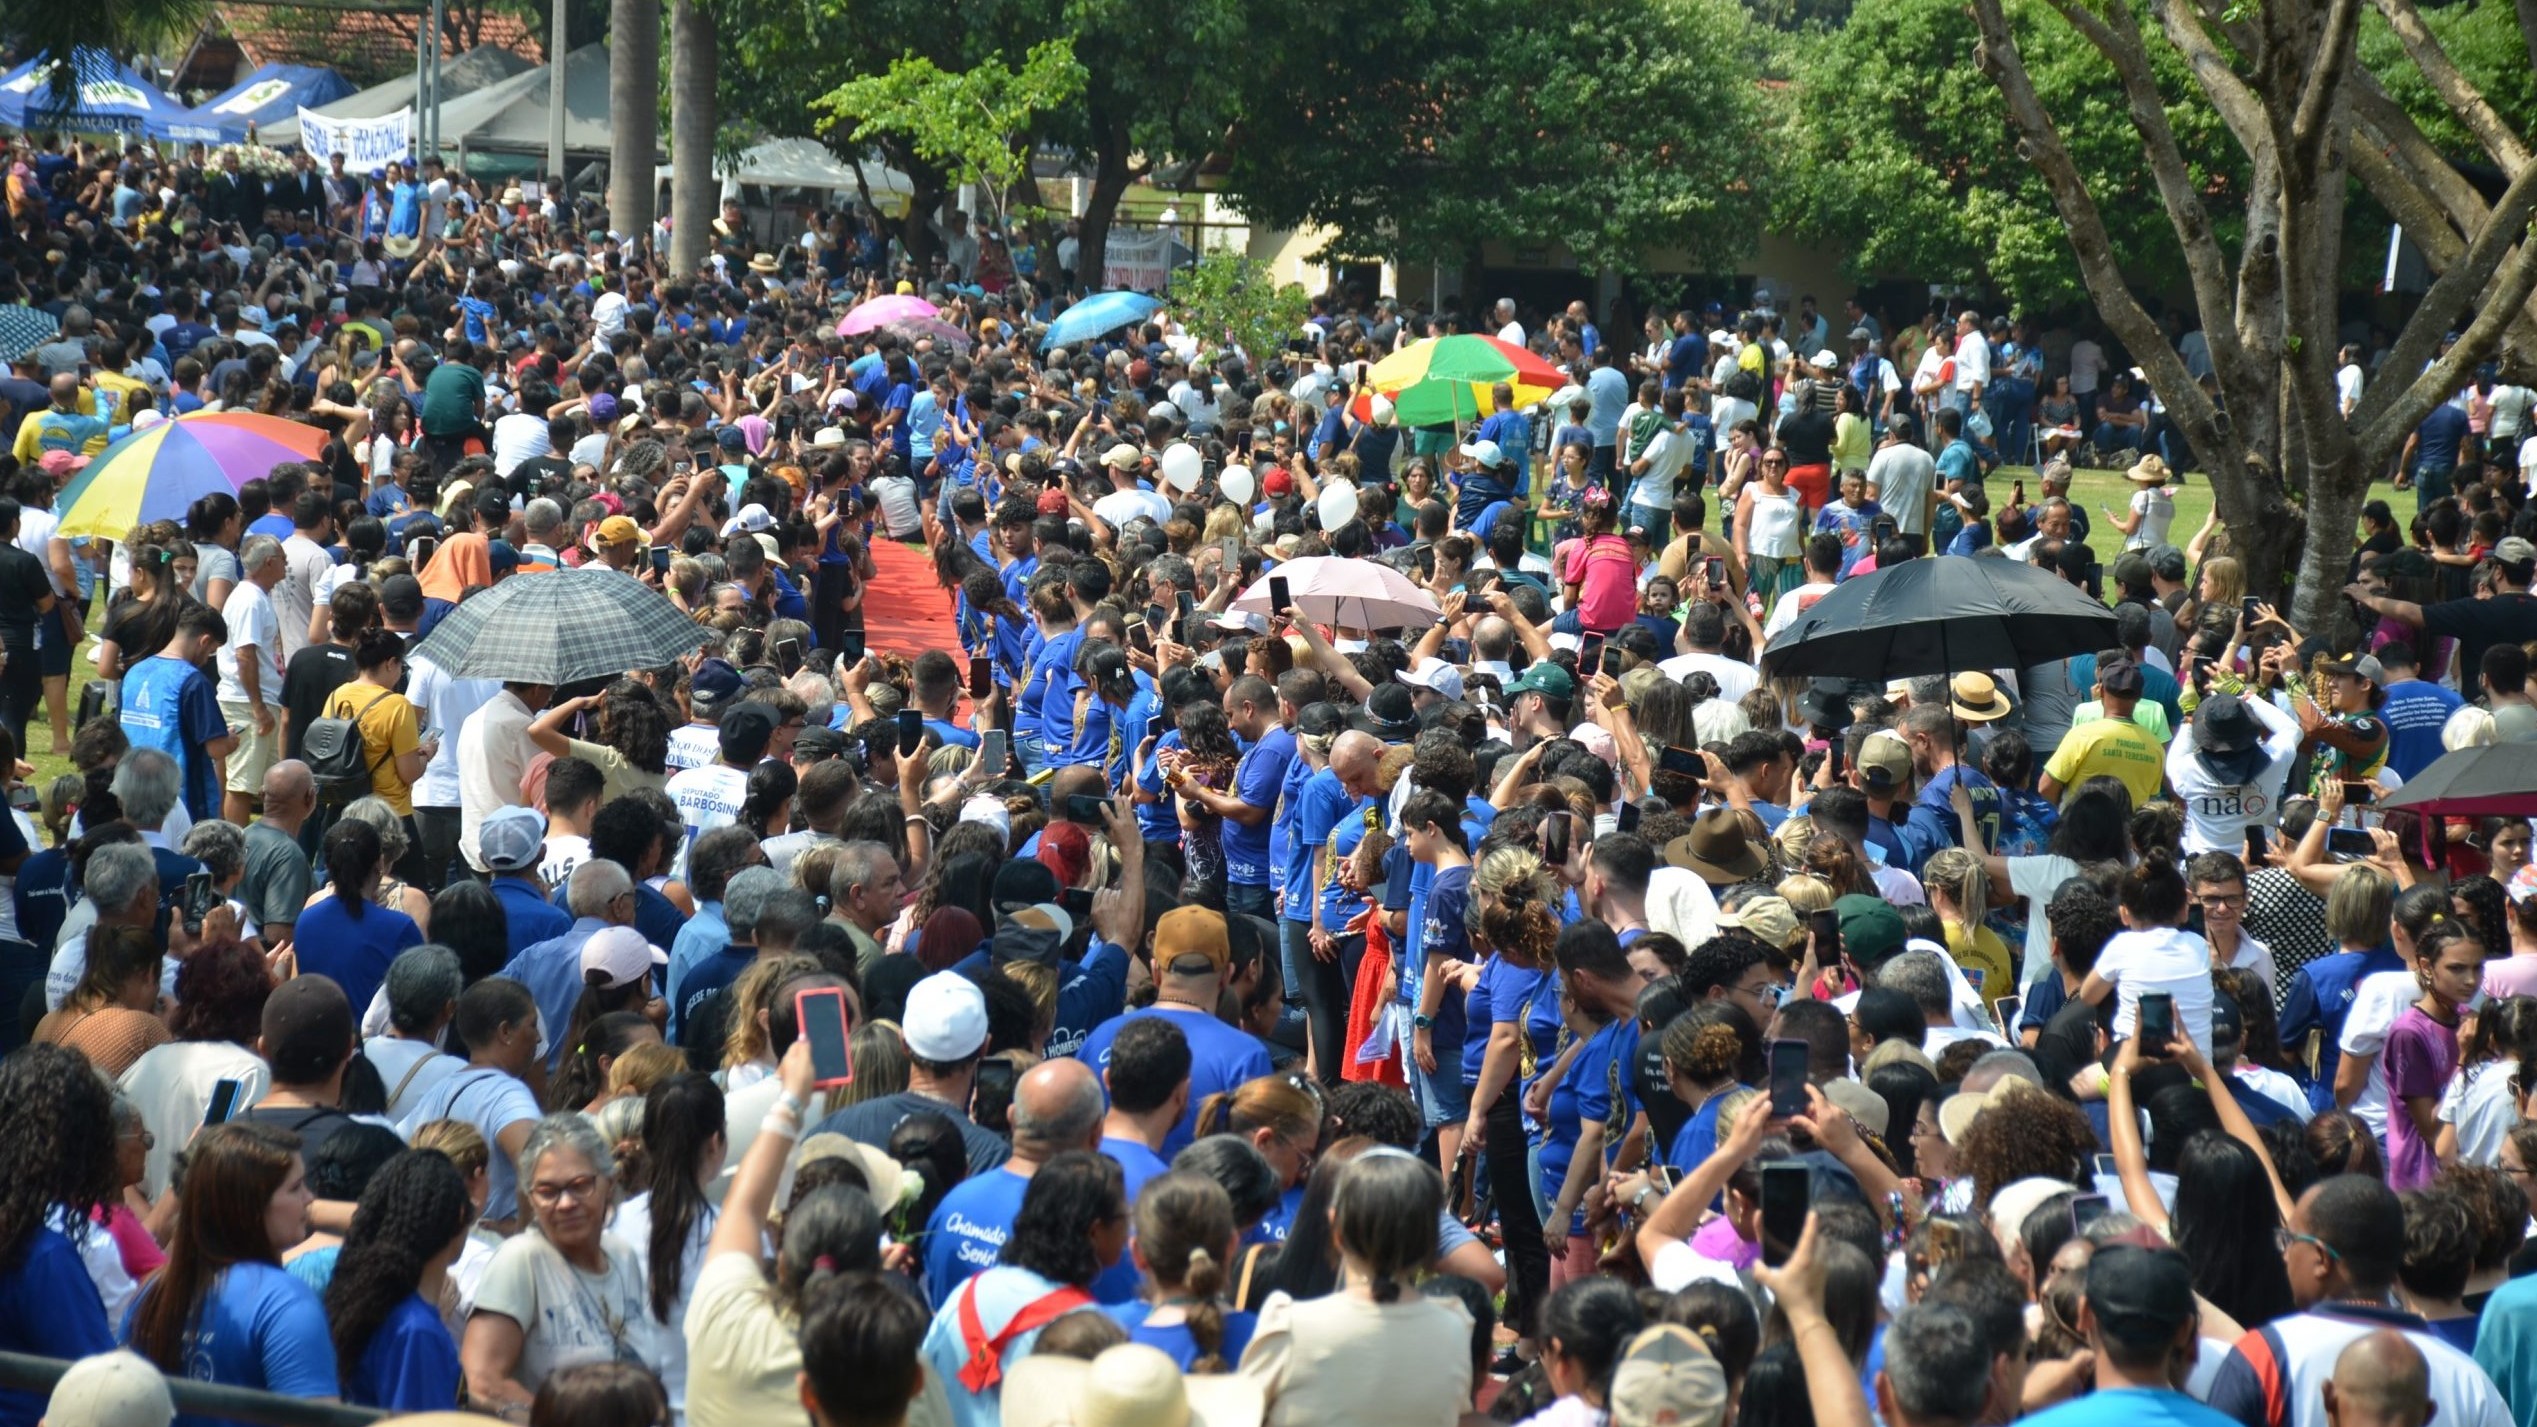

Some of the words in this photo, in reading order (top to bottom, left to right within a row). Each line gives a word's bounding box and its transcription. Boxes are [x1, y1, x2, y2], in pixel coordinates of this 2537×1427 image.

[352, 117, 405, 162] VOCACIONAL
[666, 753, 701, 768] OMENS
[2102, 748, 2122, 757] SANTA
[682, 787, 720, 800] DEPUTADO
[2202, 787, 2268, 817] não
[680, 795, 741, 817] BARBOSINH
[542, 856, 574, 889] LLS
[1048, 1039, 1083, 1058] HOMENS
[945, 1212, 1006, 1247] Chamado
